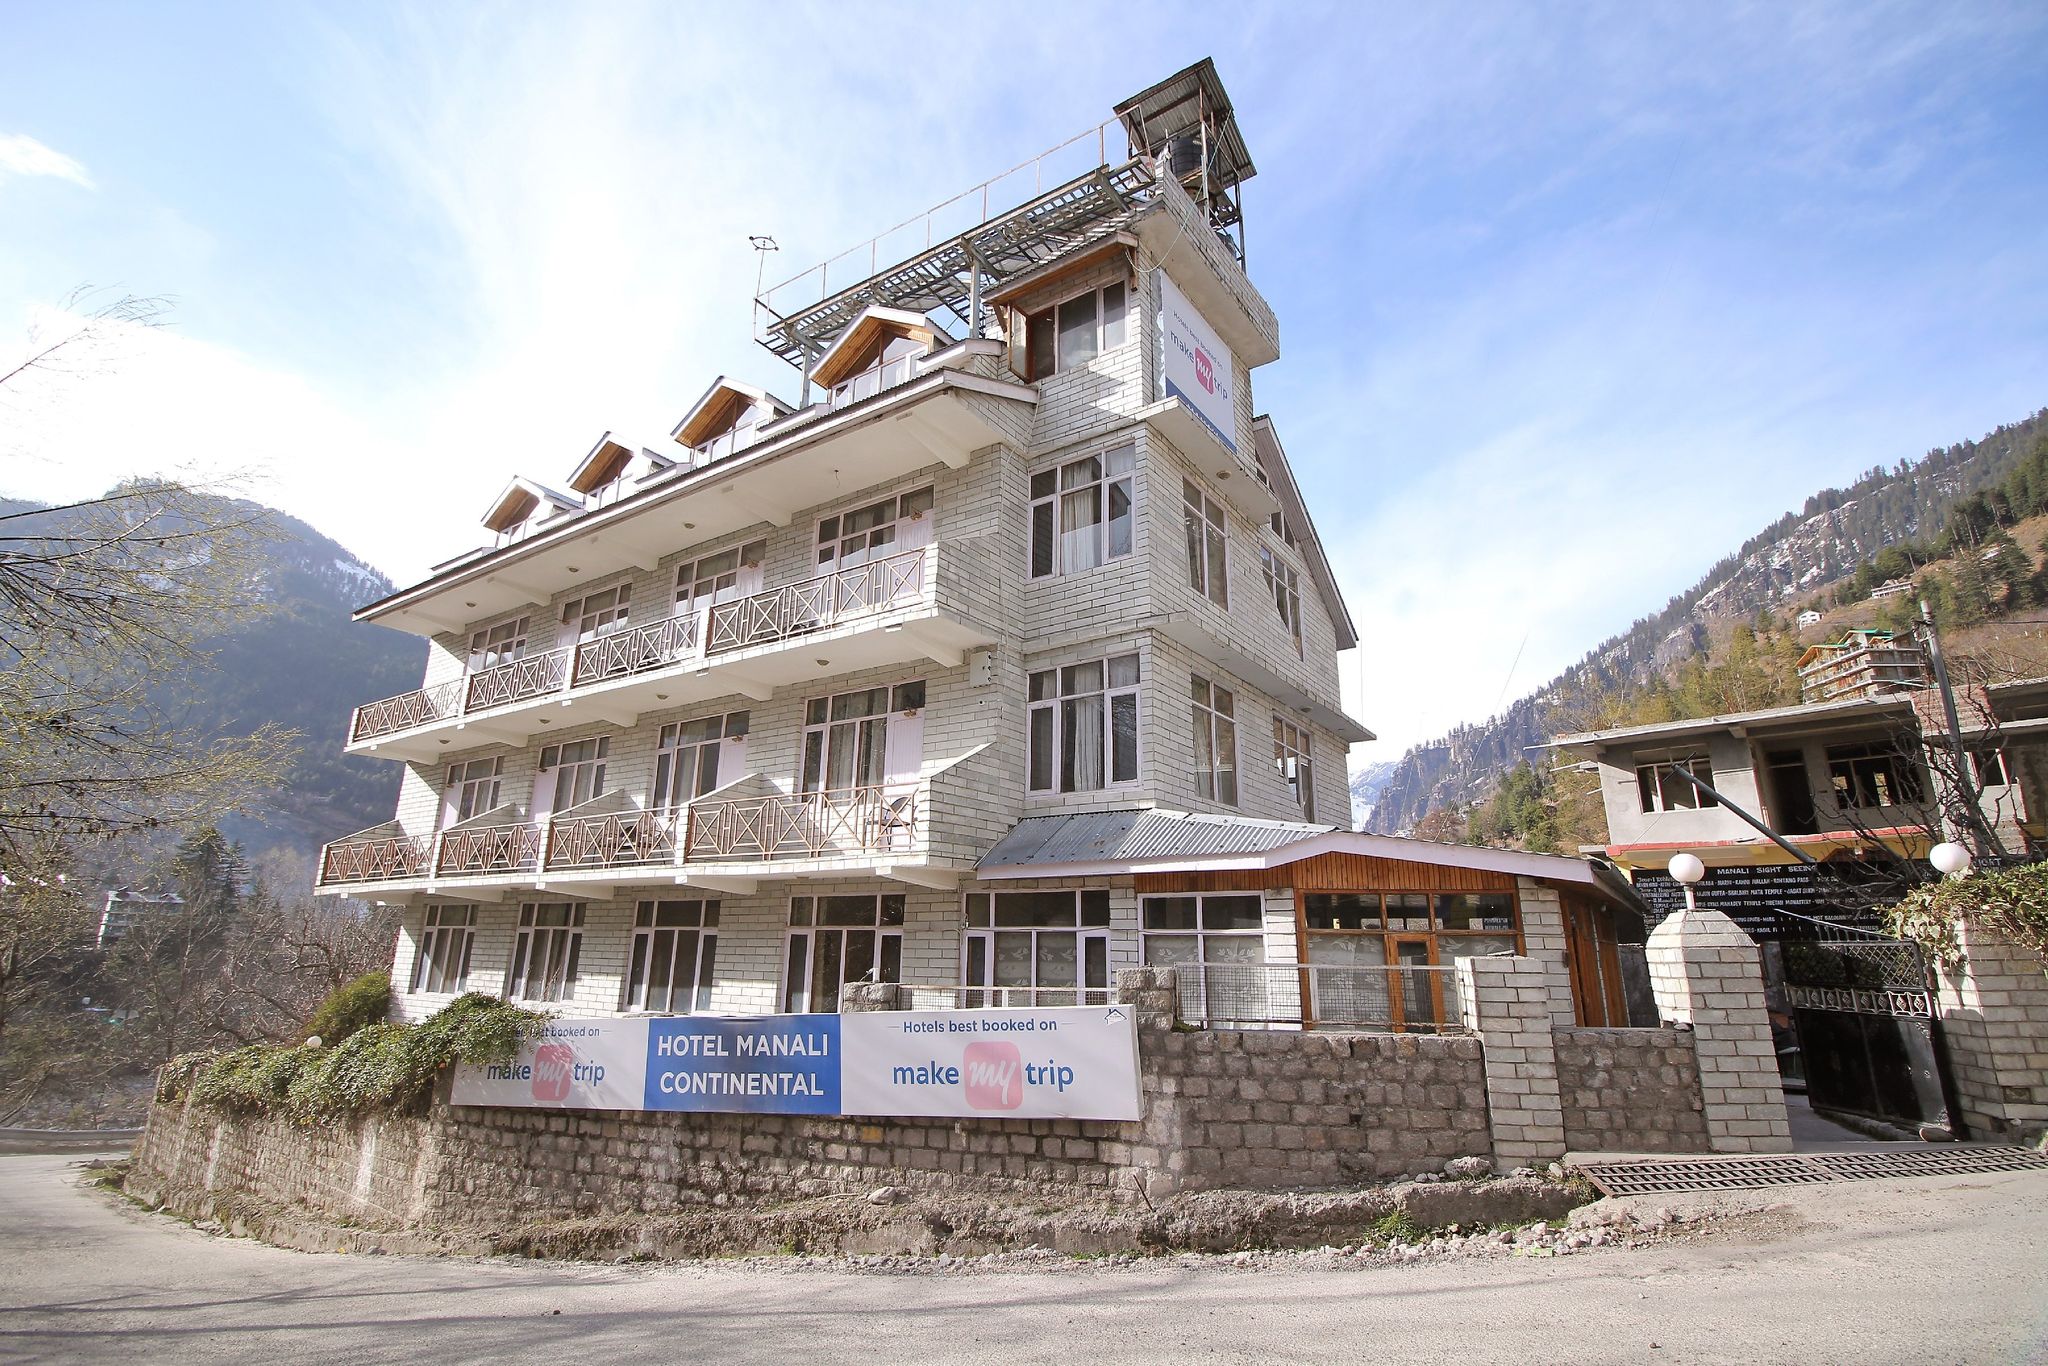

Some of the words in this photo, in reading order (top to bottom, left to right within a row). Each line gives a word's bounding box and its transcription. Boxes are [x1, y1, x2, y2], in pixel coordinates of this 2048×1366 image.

[1170, 330, 1194, 364] make
[1196, 358, 1212, 390] my
[1213, 377, 1228, 400] trip
[1756, 866, 1782, 874] SIGHT
[551, 1026, 585, 1037] booked
[588, 1028, 600, 1037] on
[903, 1020, 945, 1033] Hotels
[949, 1020, 978, 1033] best
[982, 1018, 1034, 1032] booked
[1039, 1019, 1057, 1031] on
[657, 1035, 729, 1057] HOTEL
[736, 1034, 828, 1056] MANALI
[487, 1061, 531, 1081] make
[537, 1060, 568, 1097] my
[574, 1060, 605, 1087] trip
[659, 1071, 824, 1096] CONTINENTAL
[893, 1060, 959, 1085] make
[969, 1060, 1016, 1105] my
[1025, 1059, 1074, 1093] trip
